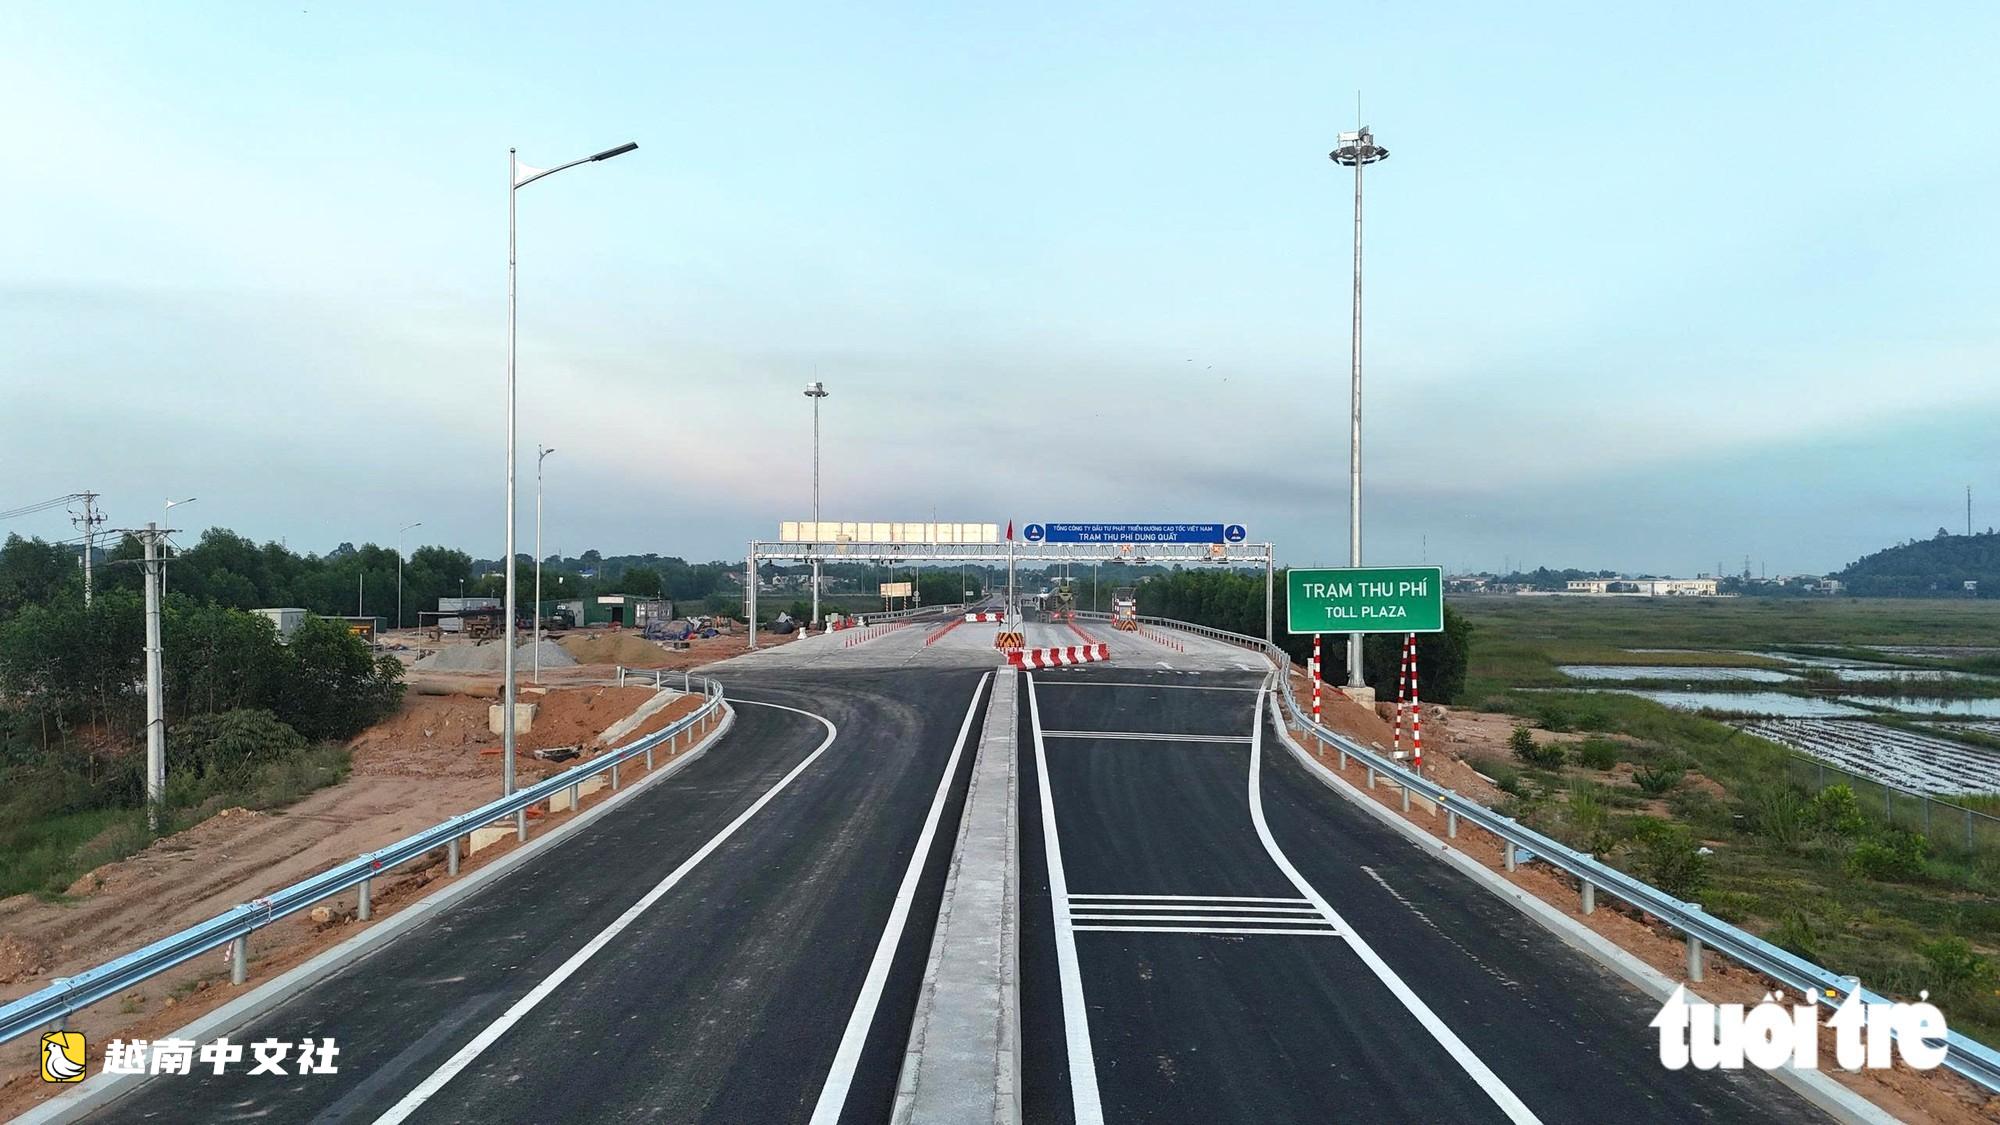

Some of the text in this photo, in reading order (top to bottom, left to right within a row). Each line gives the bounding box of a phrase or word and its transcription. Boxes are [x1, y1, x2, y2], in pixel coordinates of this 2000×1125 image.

[1068, 524, 1082, 532] CÔNG
[1120, 532, 1133, 540] PHÍ
[1157, 532, 1178, 541] QUẤT
[1303, 577, 1428, 601] TRẠM THU PHÍ
[1325, 606, 1407, 618] TOLL PLAZA
